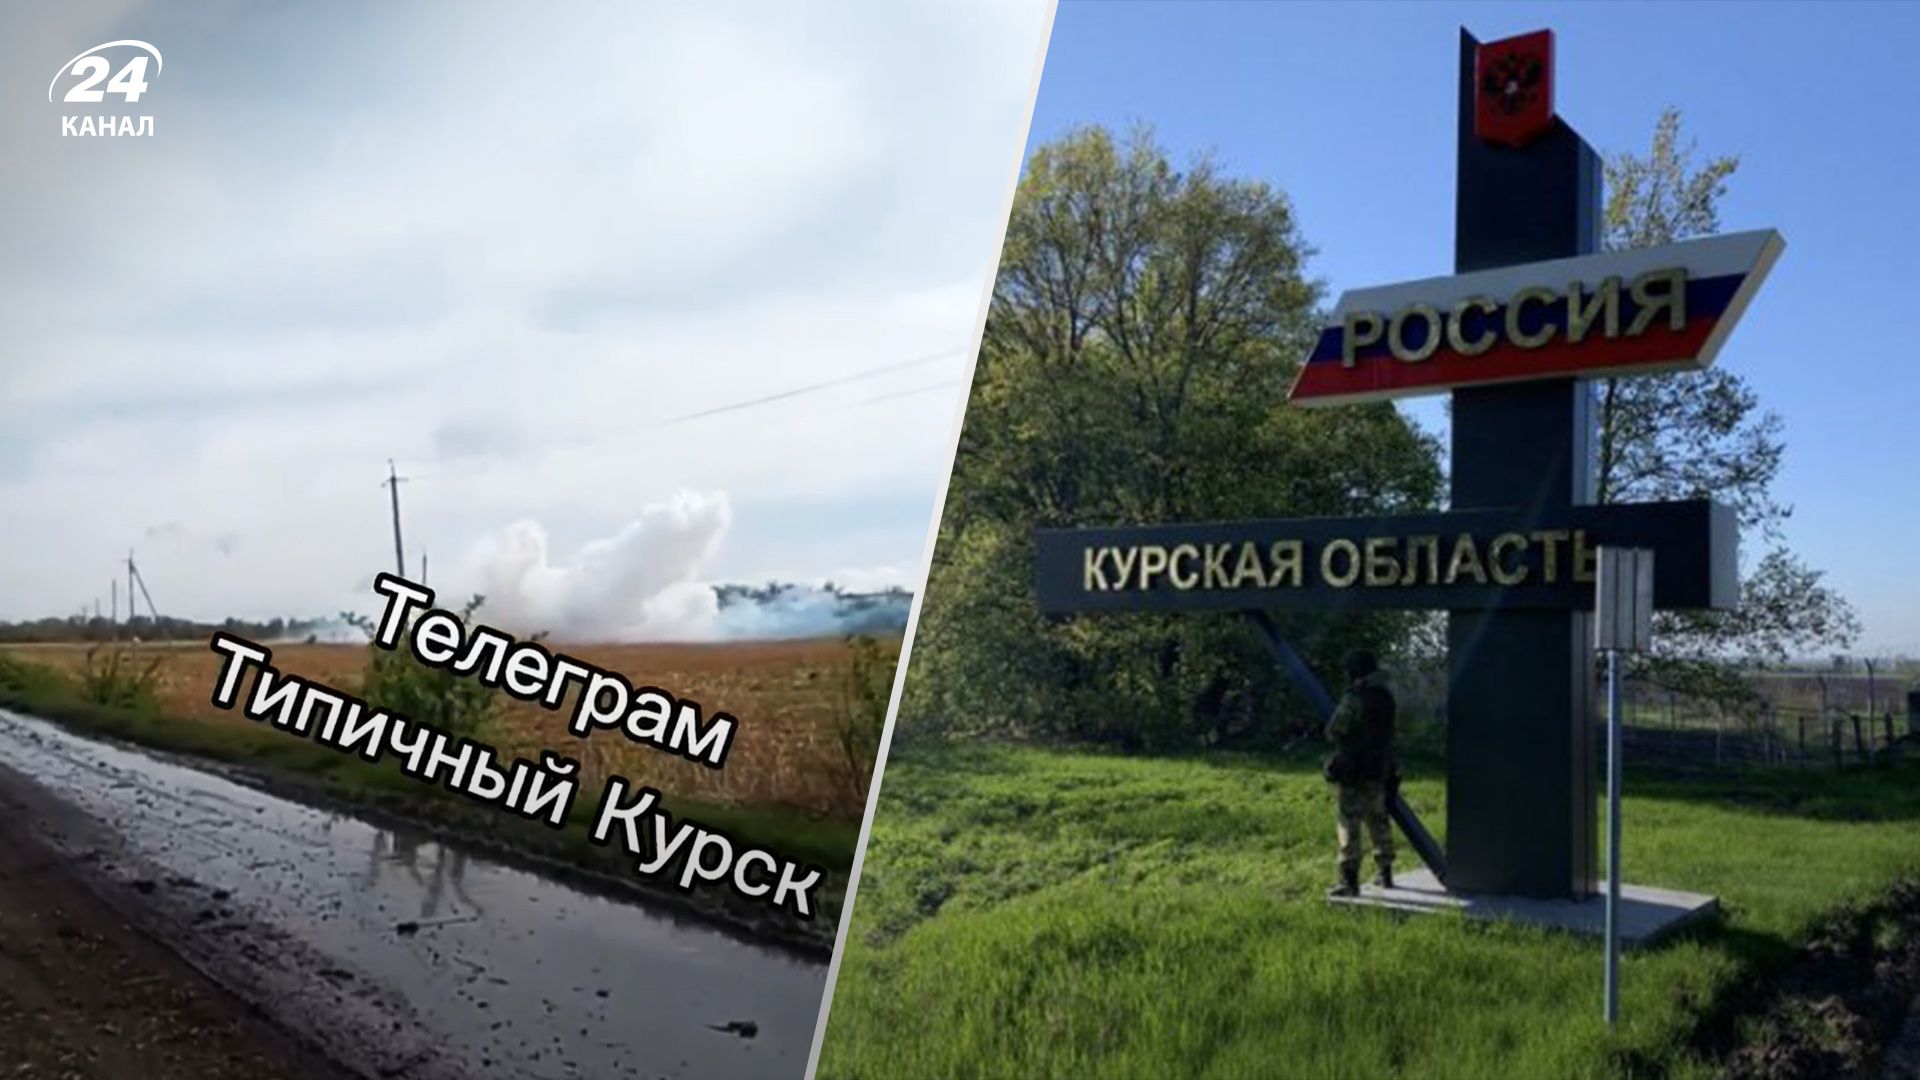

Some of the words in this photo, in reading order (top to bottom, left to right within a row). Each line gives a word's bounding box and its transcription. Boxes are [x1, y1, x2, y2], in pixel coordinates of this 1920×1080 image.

[1341, 266, 1689, 369] РОССИЯ
[1083, 538, 1303, 591] КУРСКАЯ
[1320, 529, 1598, 589] ОБЛАСТЬ
